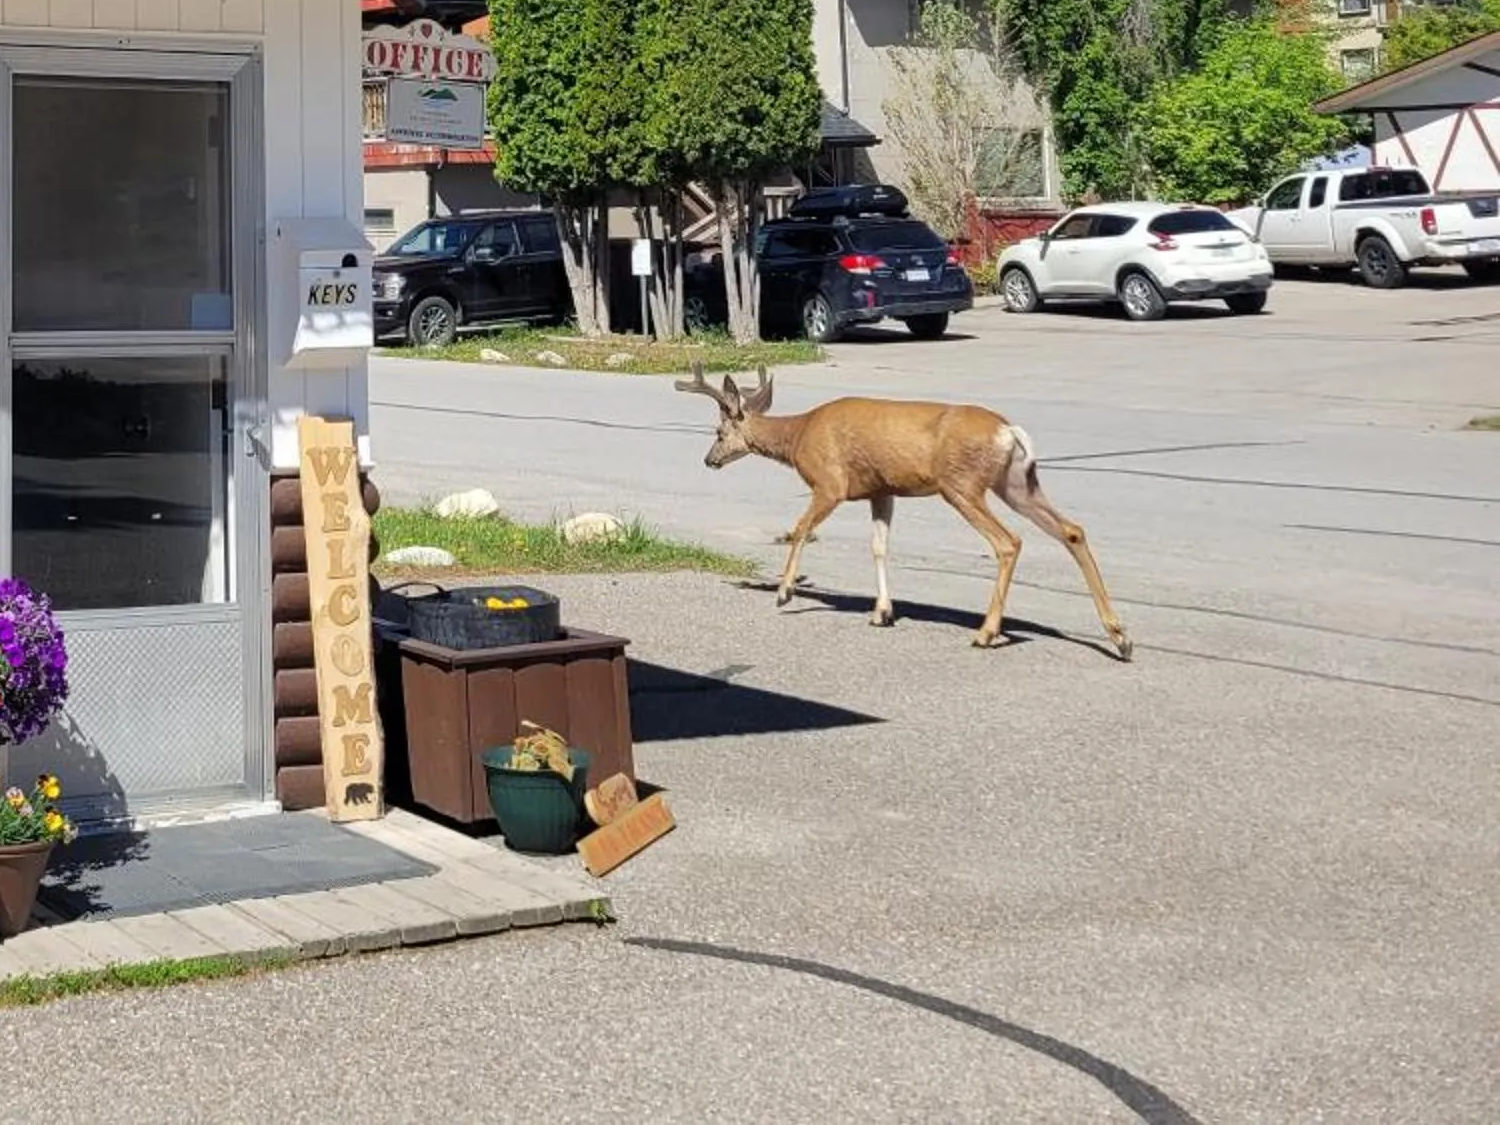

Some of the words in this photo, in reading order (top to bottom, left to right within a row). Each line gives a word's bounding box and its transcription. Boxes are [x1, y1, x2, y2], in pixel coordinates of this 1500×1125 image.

[366, 40, 483, 78] OFFICE
[307, 283, 357, 306] KEYS
[306, 445, 372, 777] WELCOME
